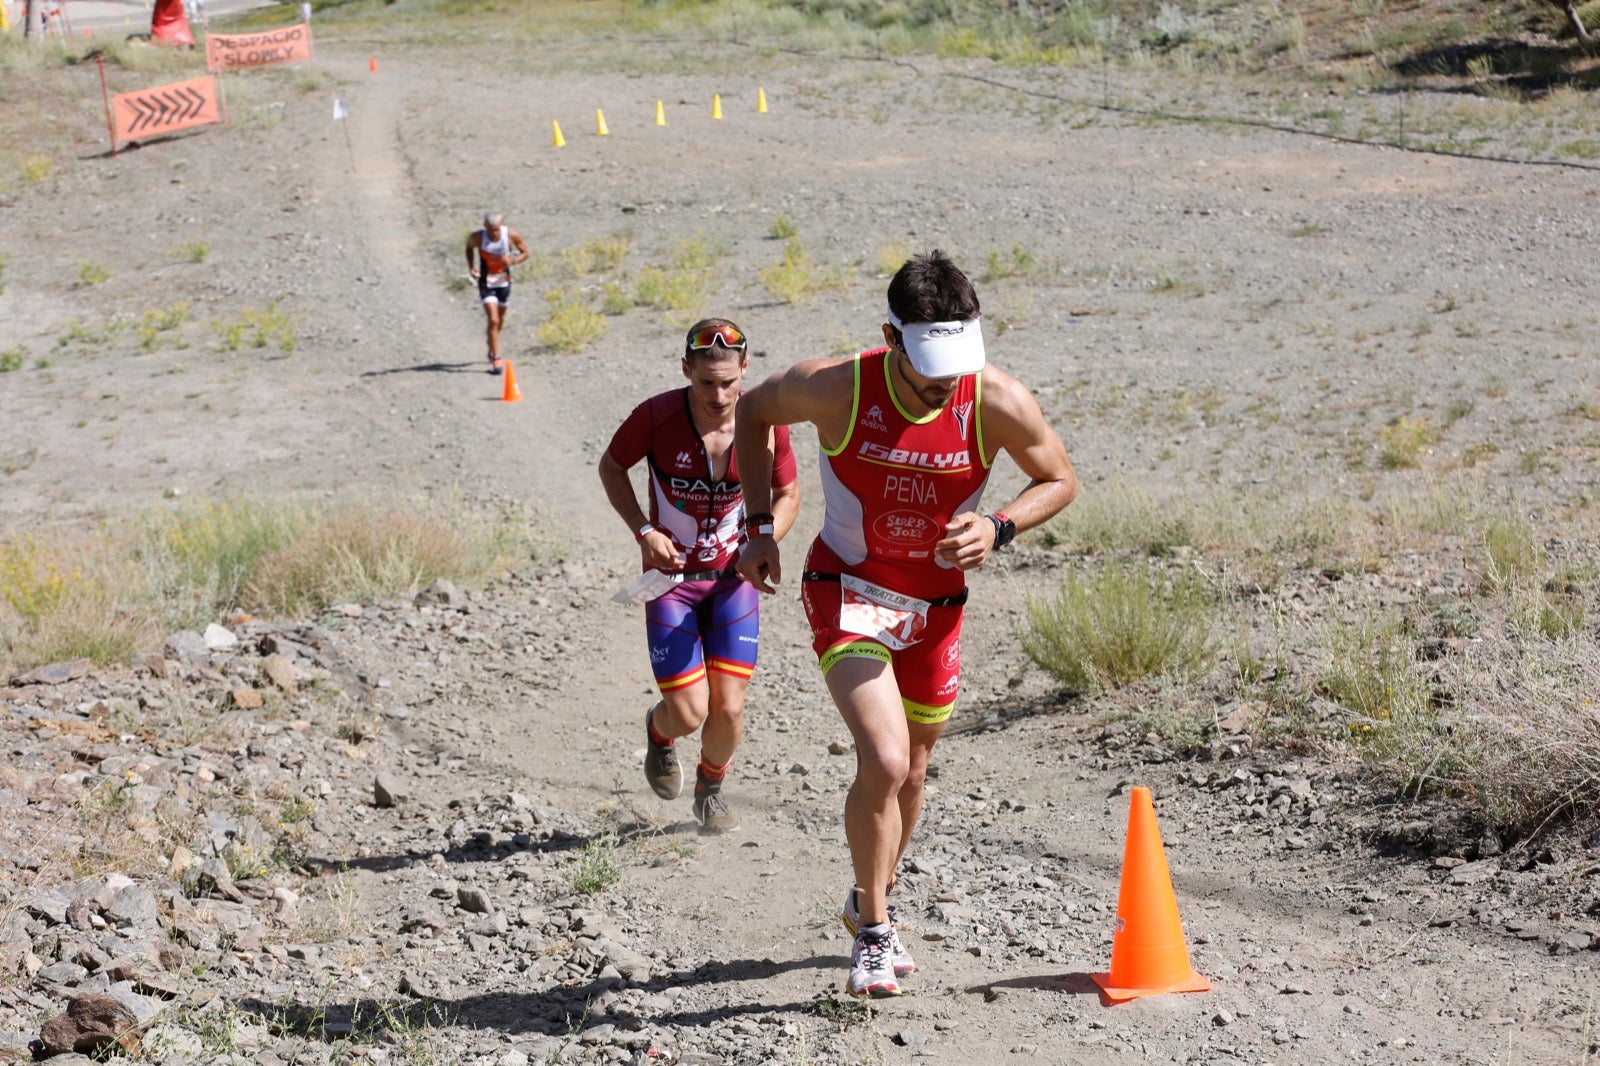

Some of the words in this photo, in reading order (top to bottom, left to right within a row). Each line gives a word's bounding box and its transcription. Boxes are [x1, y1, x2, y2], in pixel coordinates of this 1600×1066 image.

[214, 29, 302, 49] DESPACIO
[224, 46, 293, 66] SLOWLY
[859, 441, 970, 468] ISBILYA
[883, 473, 938, 505] PEÑA
[864, 585, 911, 606] TRIATLON
